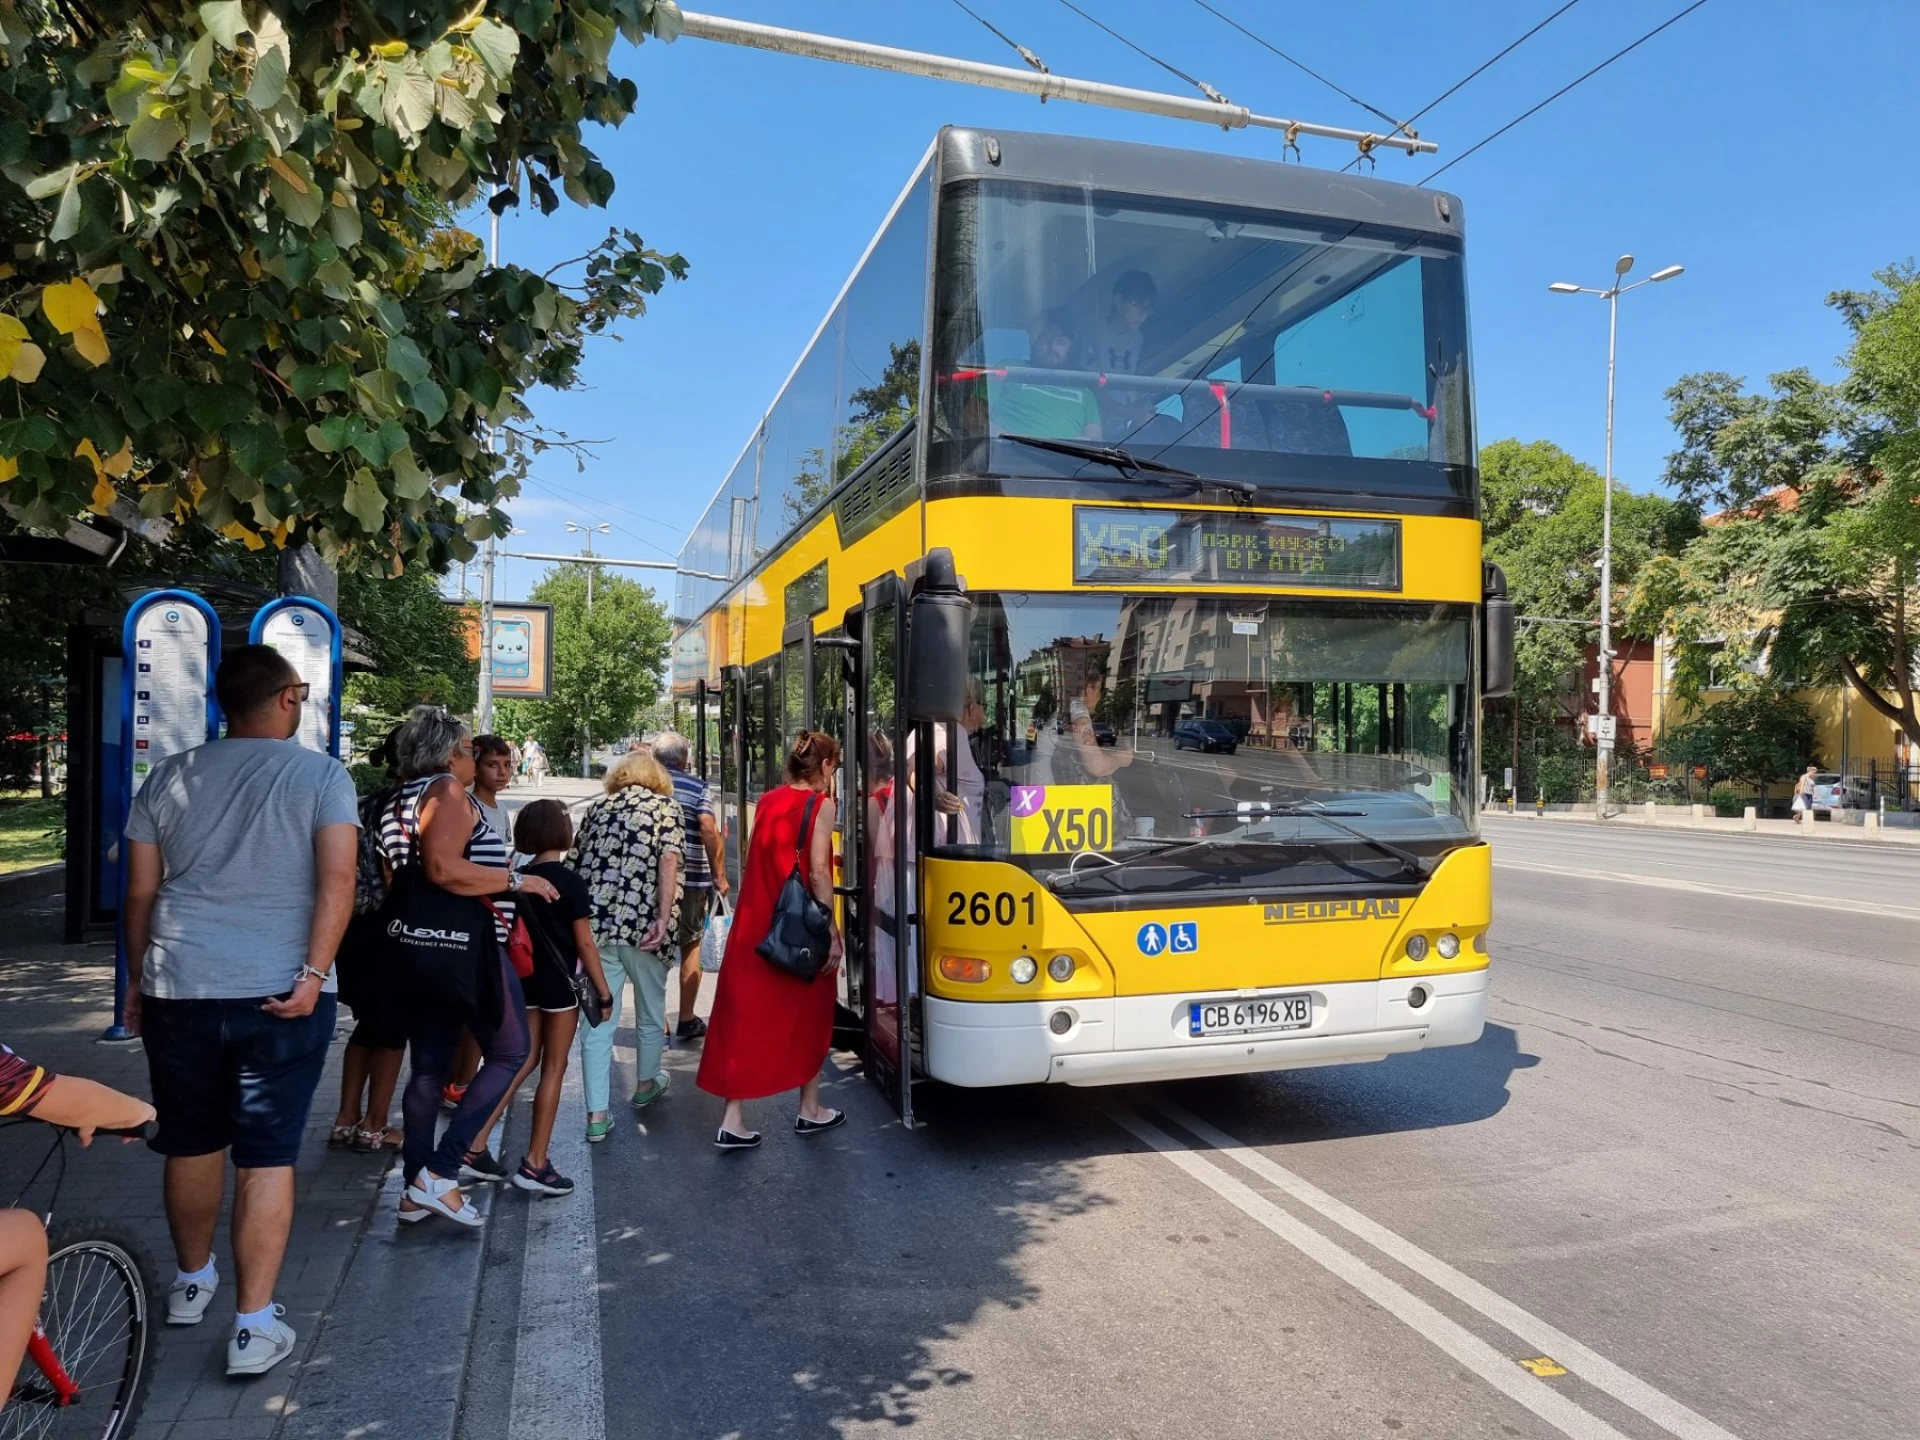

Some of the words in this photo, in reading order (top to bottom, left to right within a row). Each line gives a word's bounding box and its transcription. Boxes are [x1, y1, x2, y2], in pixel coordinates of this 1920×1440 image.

[1080, 521, 1168, 569] X50
[1015, 789, 1038, 812] X
[1041, 807, 1109, 852] X50
[947, 891, 1035, 926] 2601
[1263, 898, 1400, 921] NEOPLAN
[400, 937, 437, 947] EXPERIENCE
[439, 942, 468, 950] AMAZING
[402, 924, 470, 942] LEXUS
[1204, 1006, 1230, 1028] CB
[1234, 1002, 1280, 1026] 6196
[1283, 1000, 1307, 1022] XB
